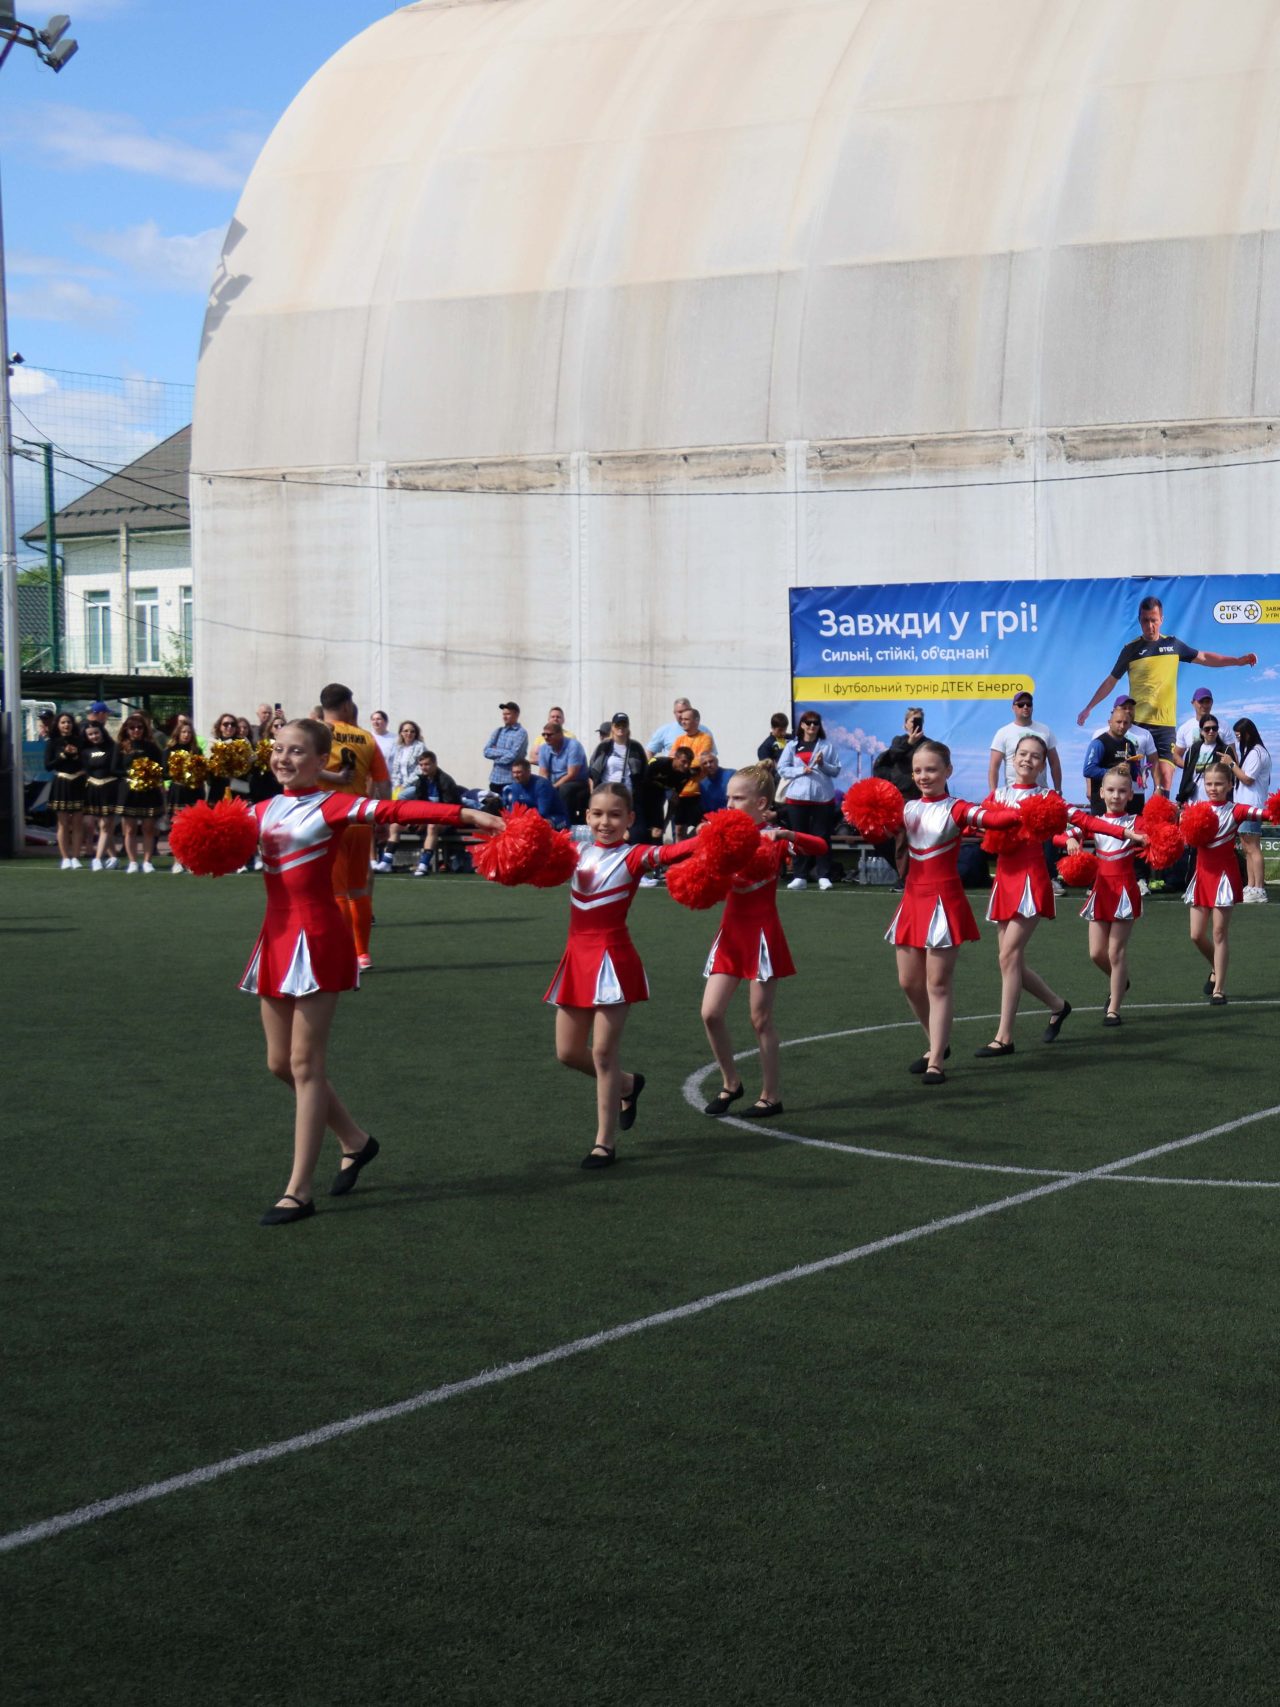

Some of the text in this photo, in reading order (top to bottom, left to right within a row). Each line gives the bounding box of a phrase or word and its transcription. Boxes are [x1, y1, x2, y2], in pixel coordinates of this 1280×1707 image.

[817, 601, 1039, 641] Завжди у грі!
[1219, 612, 1238, 620] CUP
[821, 645, 990, 663] Сильні, стійкі, об'єднані
[833, 681, 901, 695] футбольний
[905, 681, 939, 695] турнір
[941, 681, 974, 694] ДТЕК
[977, 681, 1024, 694] Енерго
